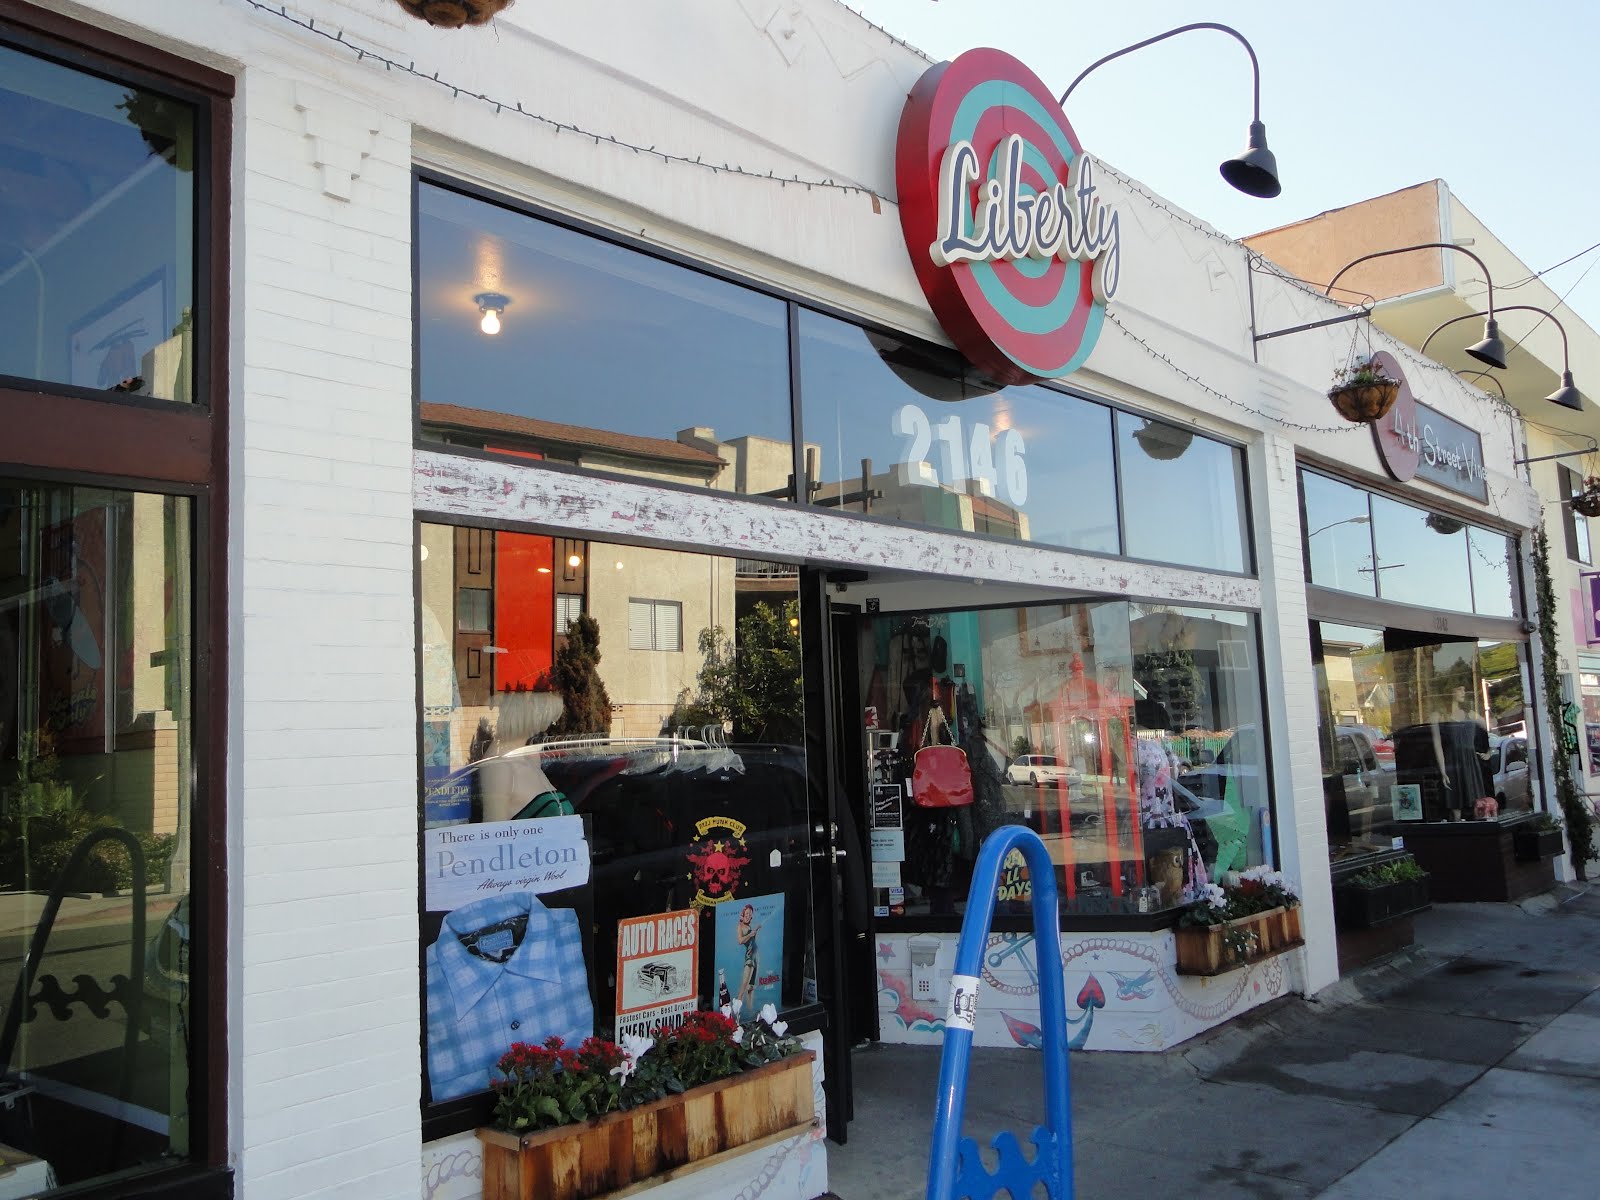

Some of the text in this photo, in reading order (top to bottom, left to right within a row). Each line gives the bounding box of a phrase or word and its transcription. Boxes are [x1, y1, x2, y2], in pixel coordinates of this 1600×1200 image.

[936, 133, 1121, 304] Liberty
[898, 404, 1028, 507] 2146
[1394, 407, 1419, 453] 4th
[1423, 423, 1462, 471] Street
[438, 825, 544, 844] There is only one
[436, 843, 577, 879] Pendleton
[476, 869, 568, 892] Always virgin Wool
[997, 880, 1032, 901] DAYS
[621, 914, 695, 958] AUTO RACES
[619, 1013, 642, 1024] Fastest
[642, 1010, 656, 1019] Cars
[660, 1005, 673, 1015] Best
[674, 1001, 694, 1012] Drivers
[619, 1010, 694, 1045] EVERY SUND
